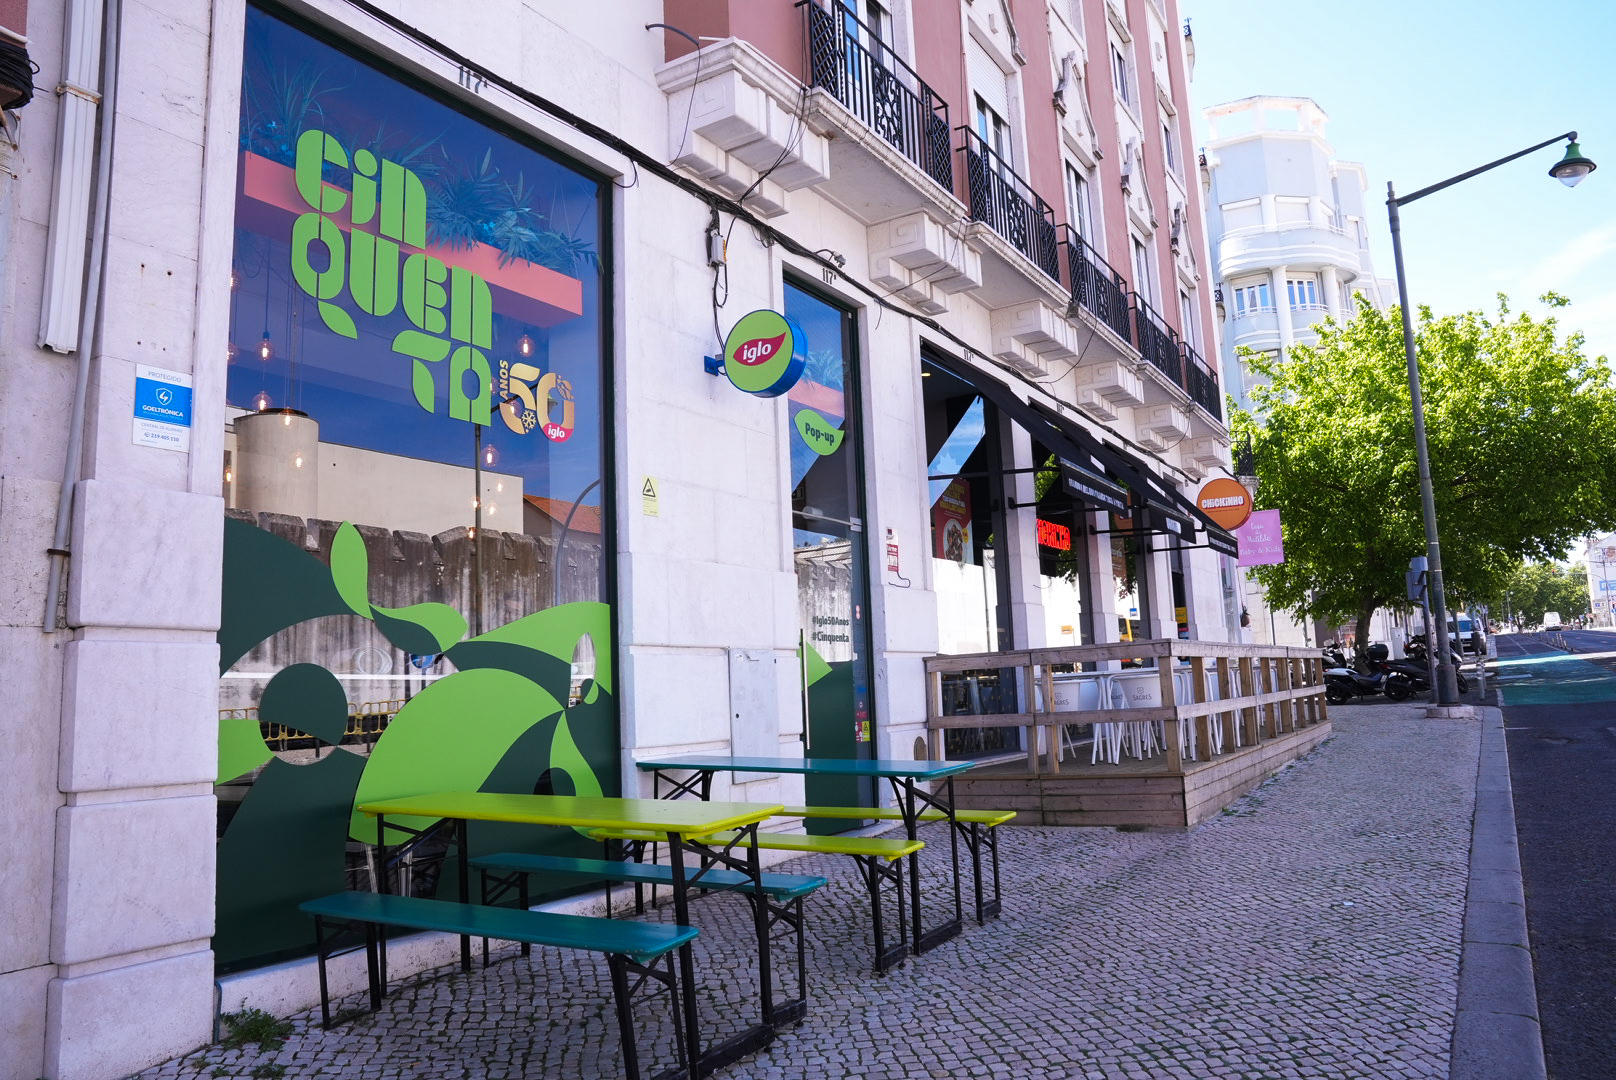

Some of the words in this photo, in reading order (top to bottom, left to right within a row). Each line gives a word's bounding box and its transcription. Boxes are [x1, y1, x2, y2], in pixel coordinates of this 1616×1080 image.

[742, 341, 772, 363] iglo
[148, 371, 182, 383] PROTEGIDO
[499, 359, 509, 401] ANOS
[547, 424, 566, 439] iglo
[805, 422, 835, 447] Pop-up
[811, 615, 850, 628] #Iglo50Anos
[811, 631, 850, 645] #Cinquenta
